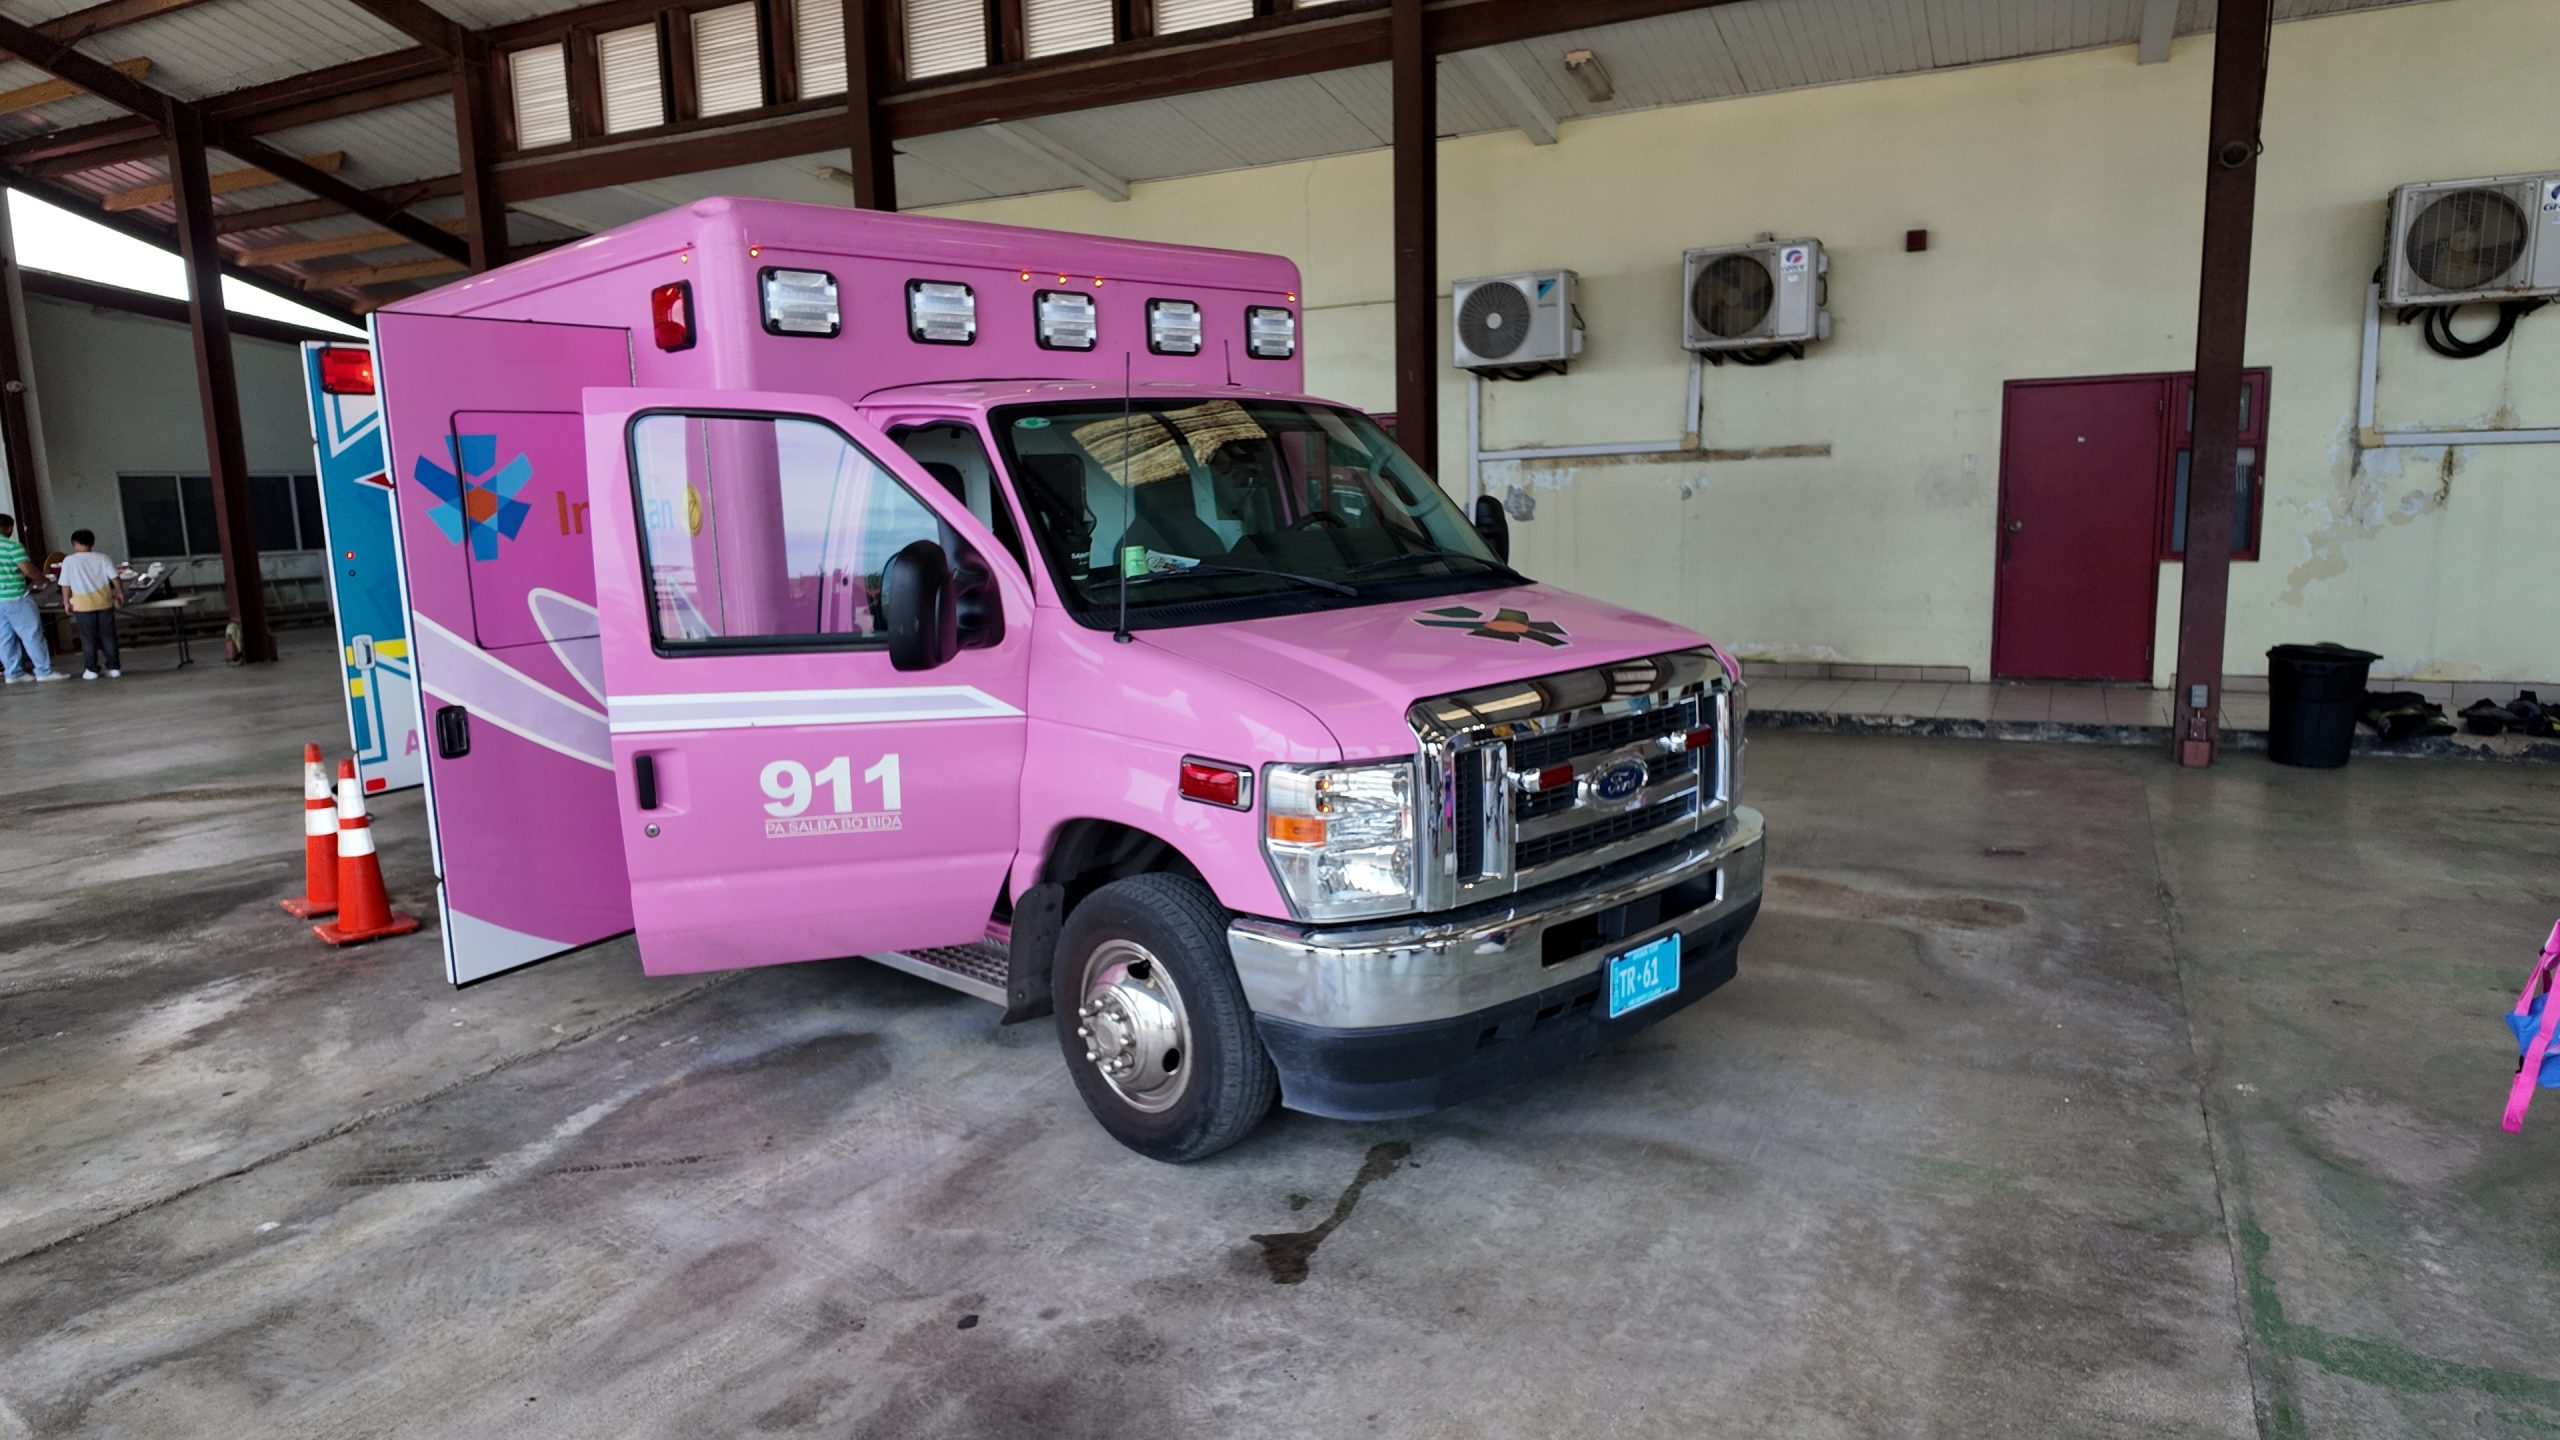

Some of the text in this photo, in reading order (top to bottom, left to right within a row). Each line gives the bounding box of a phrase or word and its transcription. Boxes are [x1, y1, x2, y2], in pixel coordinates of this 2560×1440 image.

[760, 753, 901, 818] 911
[1607, 771, 1637, 795] Ford
[765, 822, 785, 835] PA
[841, 817, 863, 830] BO
[867, 815, 902, 829] BIDA
